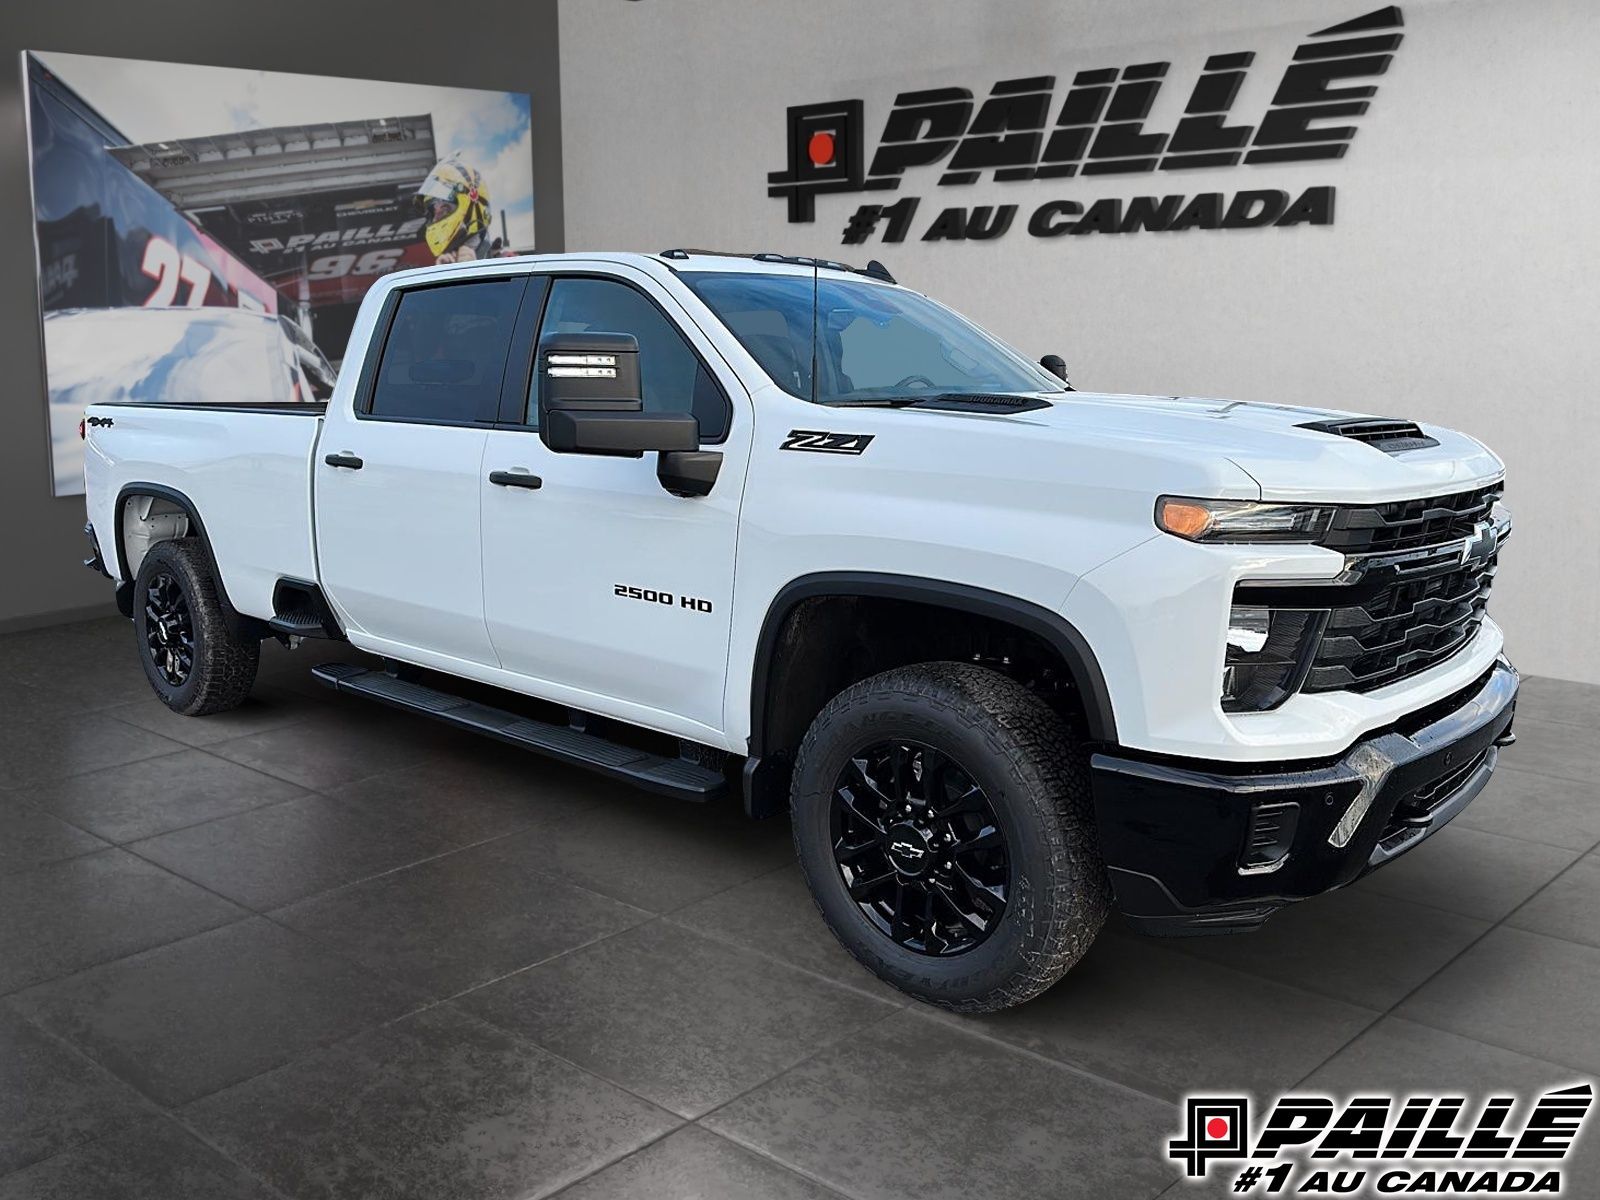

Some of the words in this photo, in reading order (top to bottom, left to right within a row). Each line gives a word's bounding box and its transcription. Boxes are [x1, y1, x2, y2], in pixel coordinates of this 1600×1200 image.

[864, 5, 1405, 191] PAILLÉ
[842, 196, 921, 245] #1
[920, 204, 1019, 242] AU
[1027, 186, 1336, 237] CANADA
[141, 235, 211, 308] 27
[308, 249, 405, 281] 96
[779, 429, 876, 456] Z71
[614, 584, 673, 606] 2500
[680, 596, 713, 614] HD
